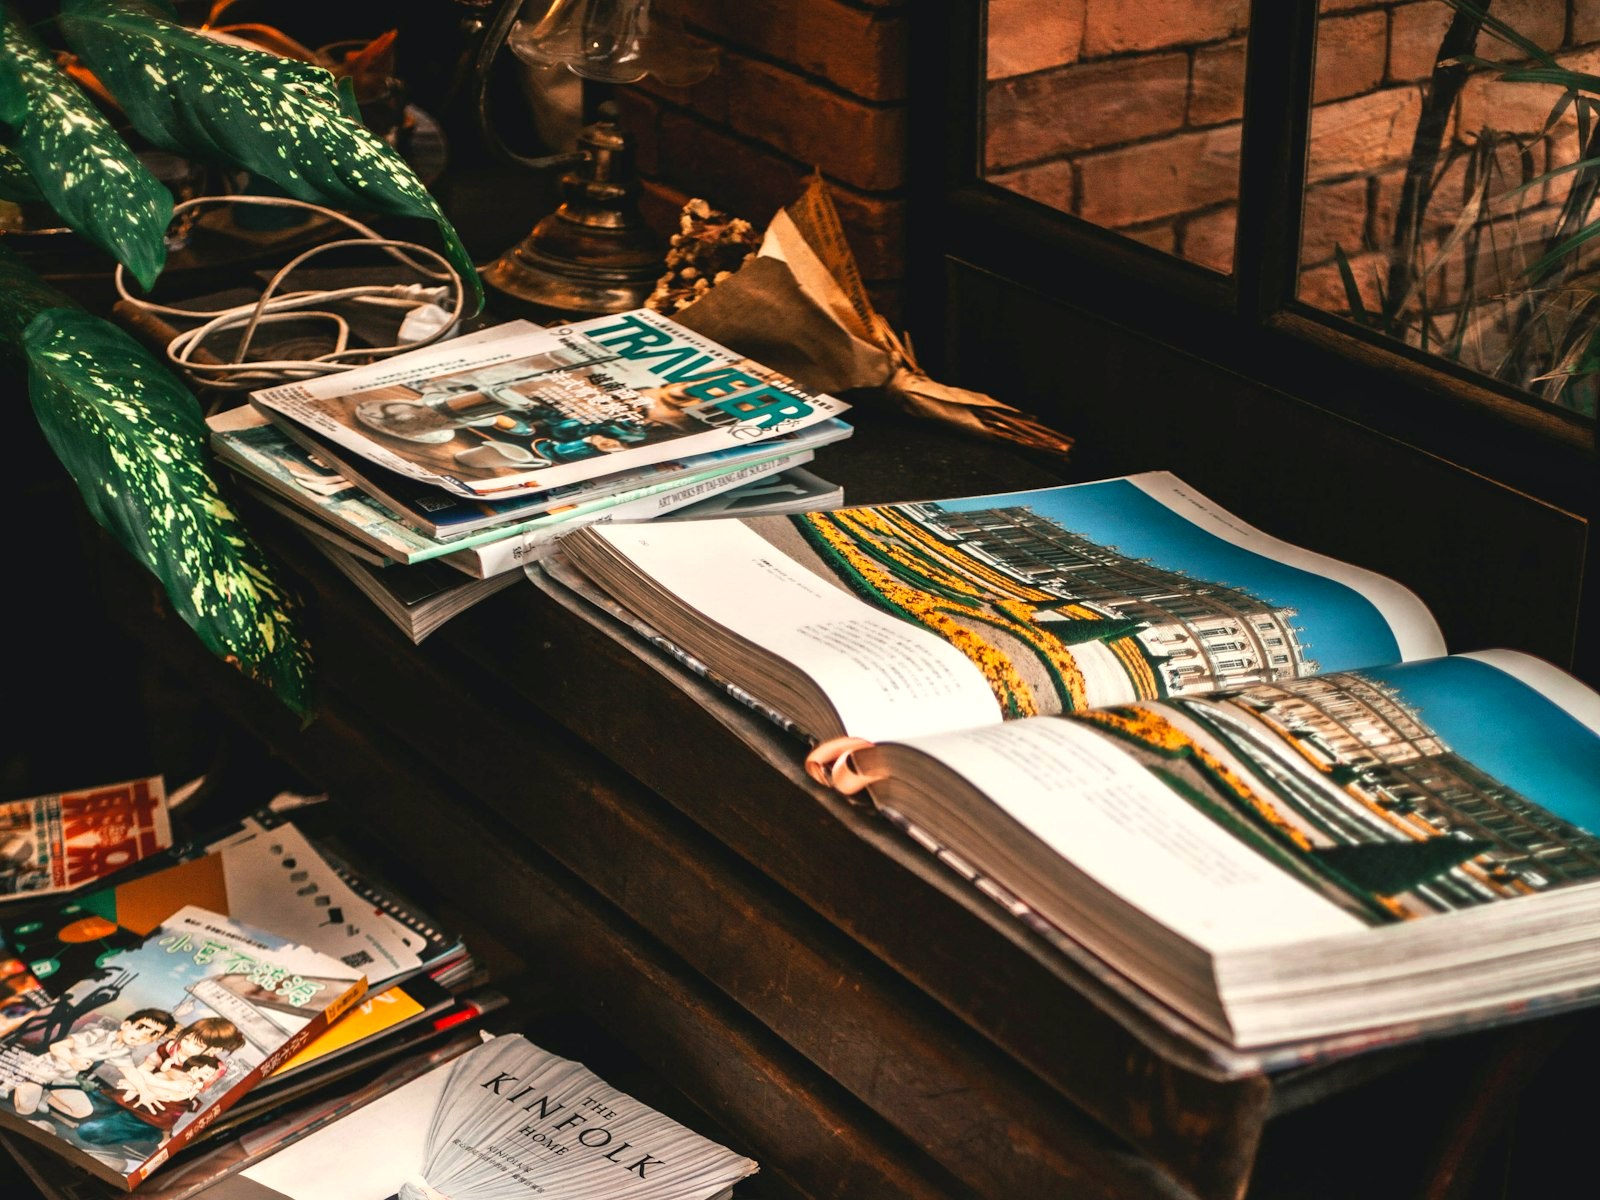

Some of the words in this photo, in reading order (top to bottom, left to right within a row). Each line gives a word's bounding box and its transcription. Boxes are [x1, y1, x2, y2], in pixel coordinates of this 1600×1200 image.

[658, 495, 671, 508] ART
[671, 489, 696, 505] WORKS
[696, 486, 705, 498] BY
[736, 471, 749, 486] ART
[480, 1072, 666, 1179] KINFOLK
[582, 1096, 617, 1121] THE
[518, 1125, 569, 1156] HOME
